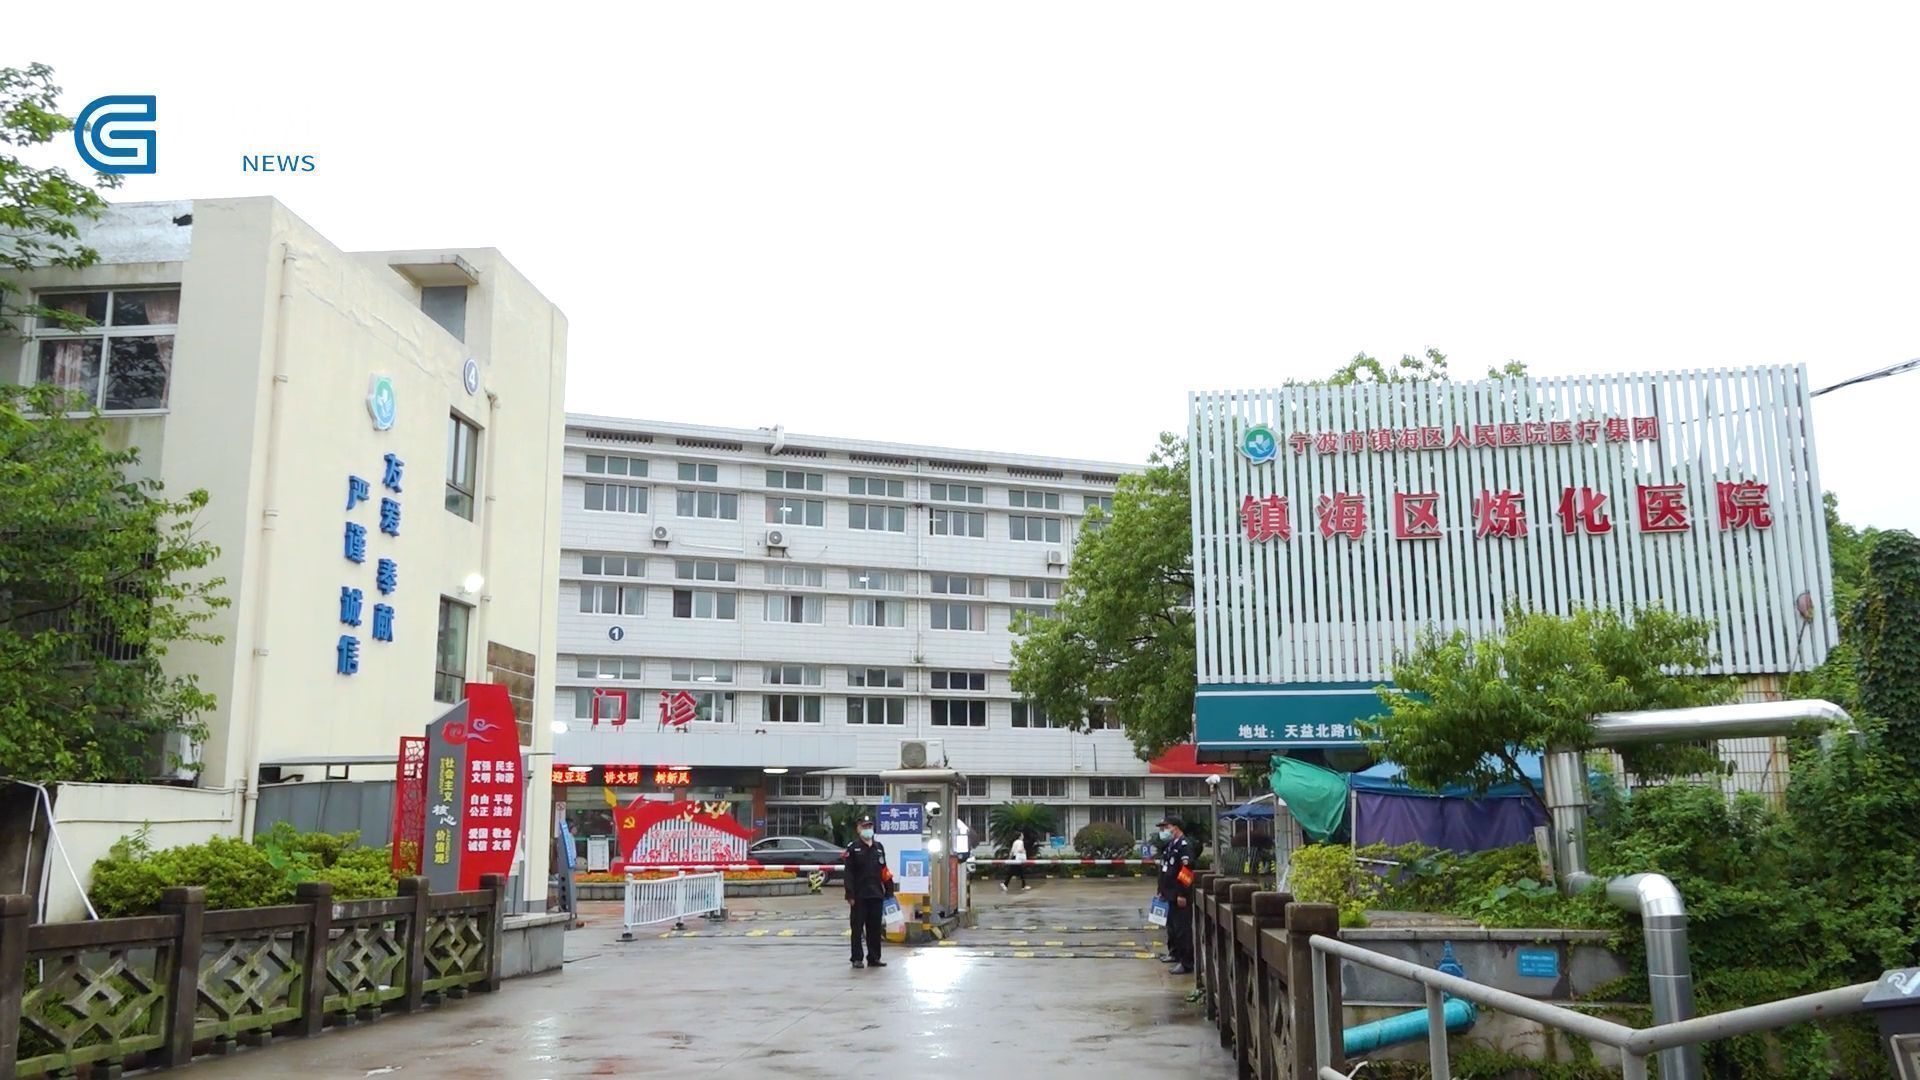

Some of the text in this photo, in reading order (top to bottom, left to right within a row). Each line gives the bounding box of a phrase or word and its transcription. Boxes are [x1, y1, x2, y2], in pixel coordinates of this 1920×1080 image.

[467, 369, 477, 387] 4
[1288, 416, 1659, 454] 宁波市镇海区人民医院医疗集团
[1240, 480, 1772, 543] 镇海区炼化医院
[592, 688, 697, 726] 门诊
[471, 761, 514, 772] 富强 民主
[471, 773, 491, 783] 文明
[604, 771, 638, 784] 讲文明
[655, 771, 690, 784] 树新风
[470, 794, 513, 805] 自由 平等
[469, 806, 512, 817] 公正 法治
